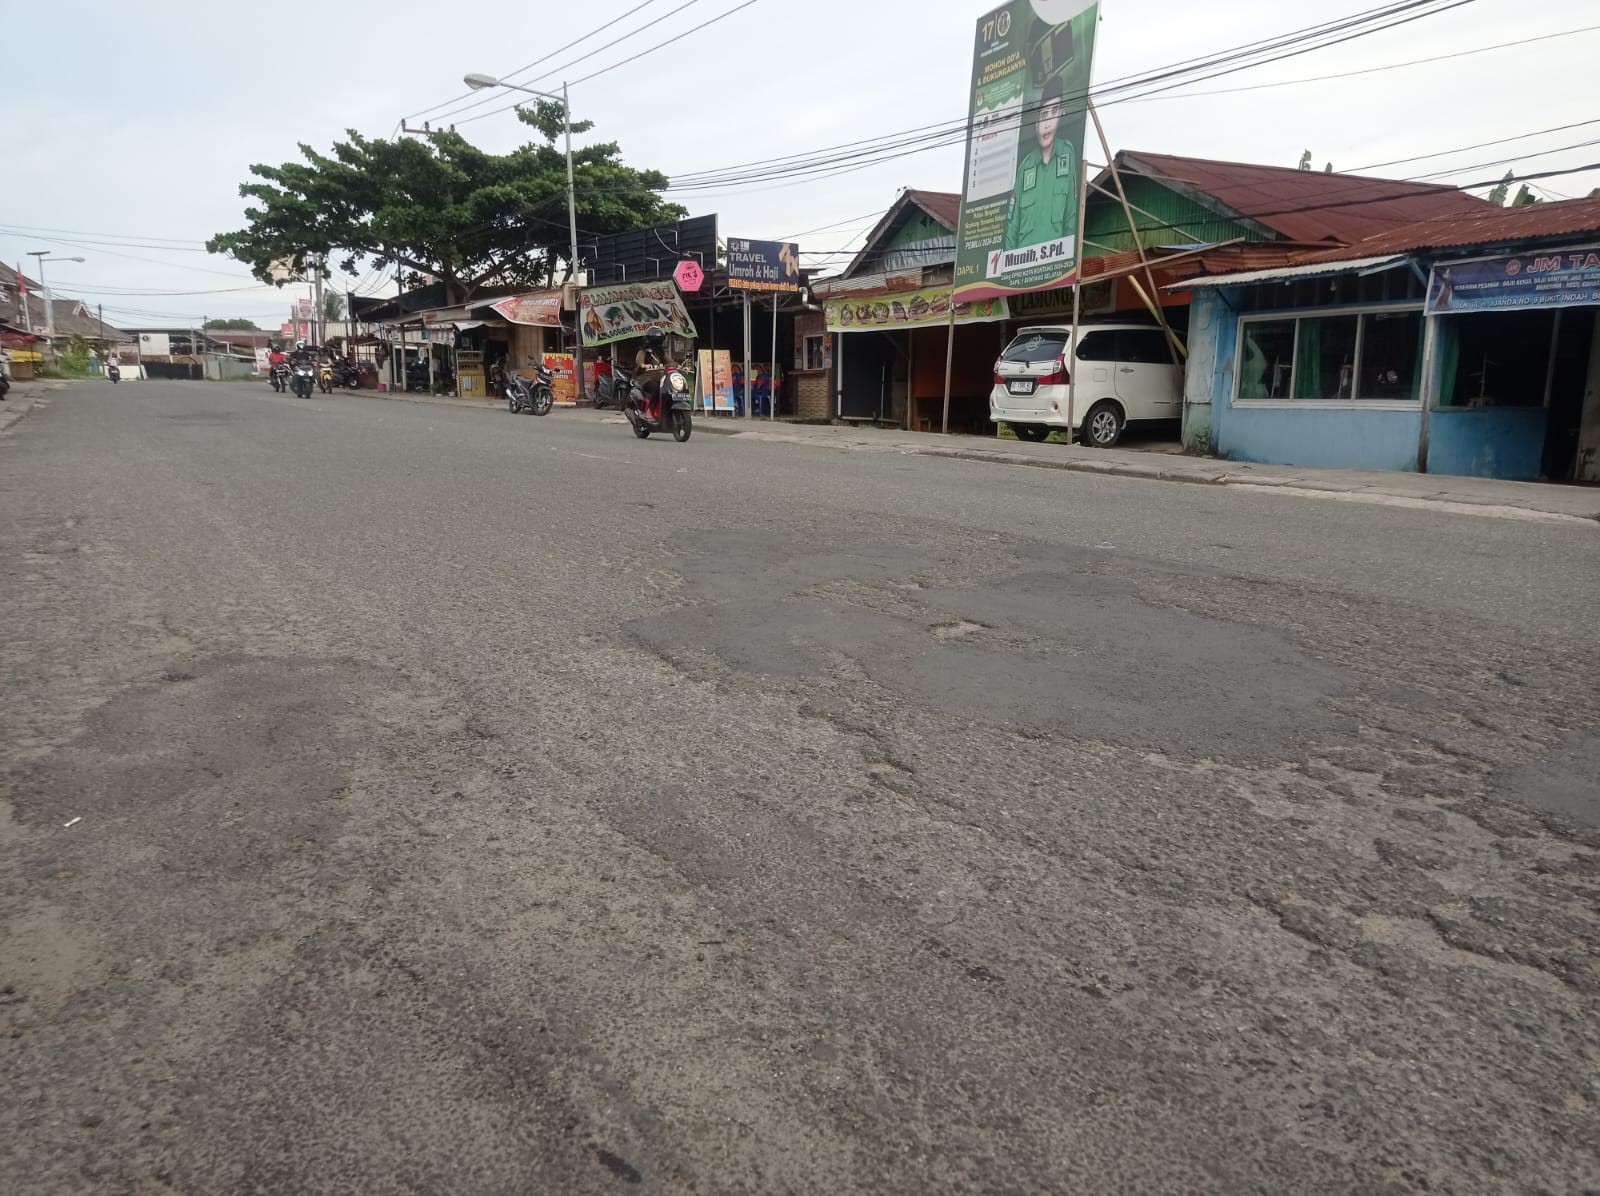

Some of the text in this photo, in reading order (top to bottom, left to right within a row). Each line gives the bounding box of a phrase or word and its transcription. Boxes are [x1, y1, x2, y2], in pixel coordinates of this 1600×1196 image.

[982, 20, 995, 42] 17
[729, 253, 767, 263] TRAVEL
[1004, 249, 1038, 268] Munib,
[1040, 242, 1065, 260] S.Pd.
[729, 263, 779, 280] Umroh & Haji
[957, 264, 979, 276] DAPIL 1
[1526, 255, 1562, 274] JM
[1540, 294, 1561, 304] BUKIT
[1561, 292, 1588, 302] INDAH
